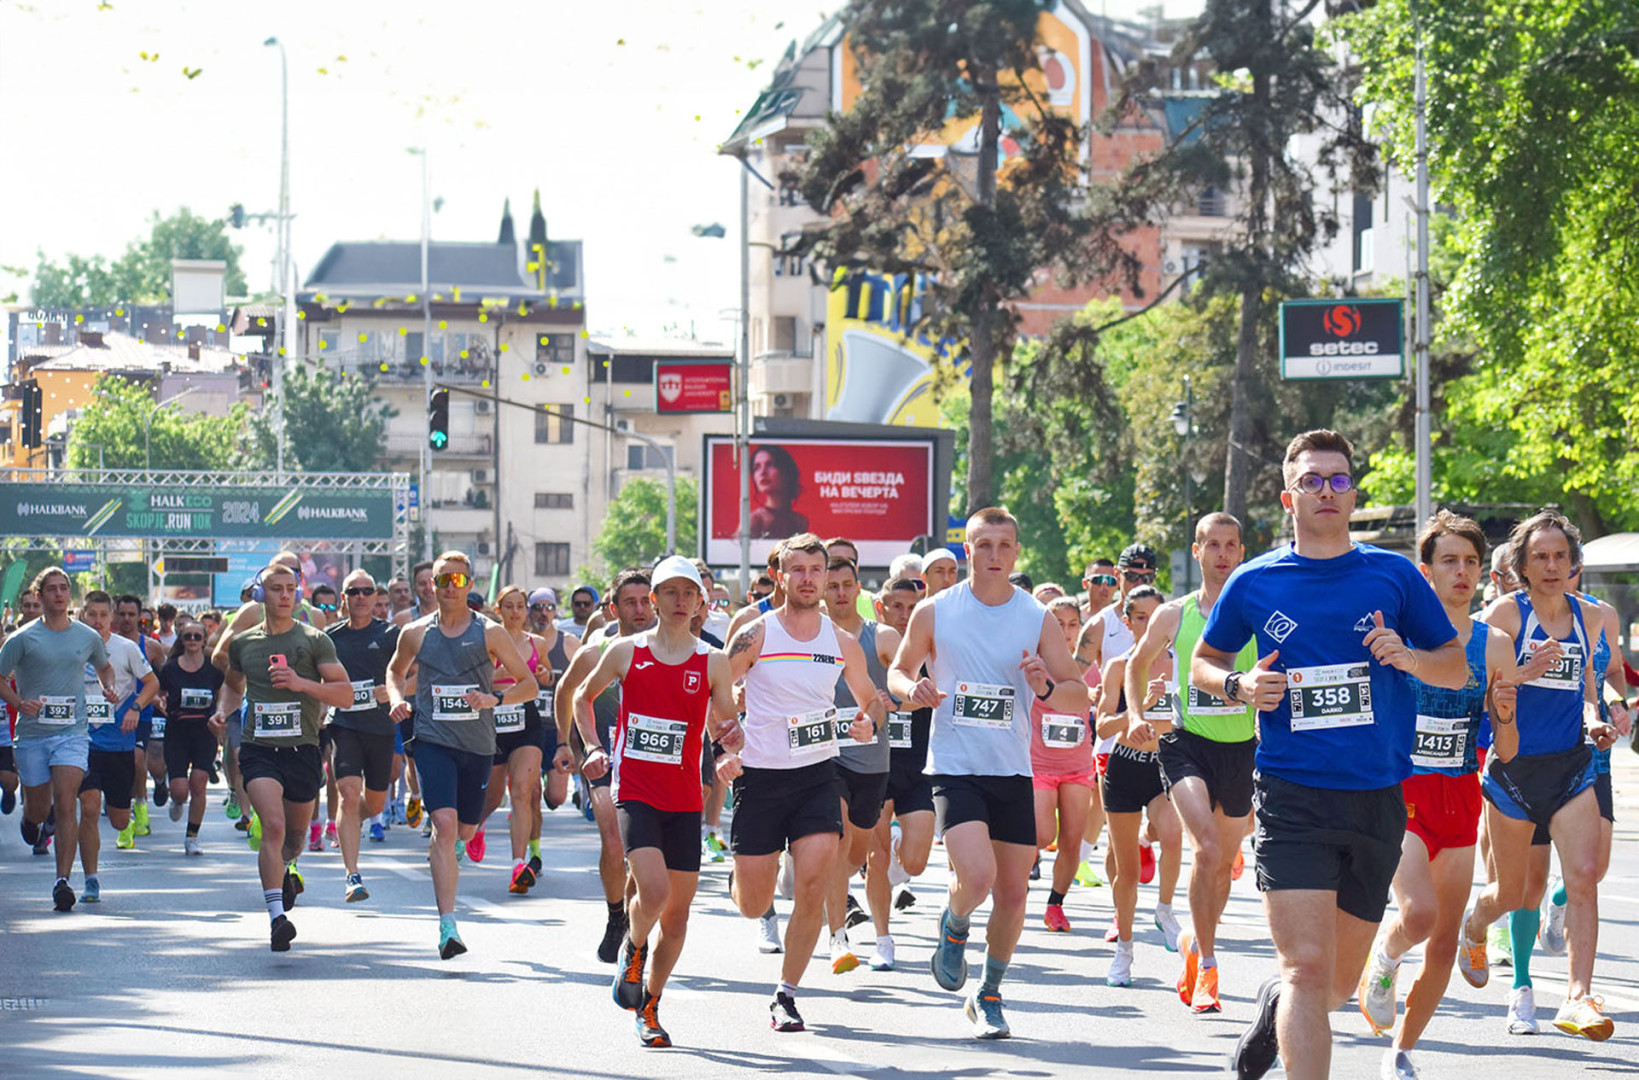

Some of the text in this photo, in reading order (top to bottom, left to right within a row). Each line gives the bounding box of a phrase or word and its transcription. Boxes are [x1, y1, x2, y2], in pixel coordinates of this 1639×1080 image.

[1309, 341, 1379, 356] setec
[814, 470, 851, 485] БИДИ
[820, 485, 899, 499] НА ВЕЧЕРТА
[30, 504, 87, 515] HALKBANK
[222, 501, 260, 523] 2024
[311, 508, 367, 518] HALKBANK
[192, 513, 212, 529] 10K
[813, 653, 836, 664] 226ERS
[688, 676, 698, 686] P
[441, 698, 470, 708] 1543
[1311, 687, 1351, 706] 358
[49, 706, 67, 715] 392
[86, 705, 105, 713] 904
[972, 699, 998, 713] 747
[267, 715, 288, 725] 391
[496, 714, 518, 723] 1633
[805, 724, 825, 738] 161
[836, 722, 852, 734] 10
[1059, 727, 1068, 737] 4
[640, 732, 669, 747] 966
[1417, 734, 1453, 750] 1413
[1114, 745, 1148, 762] NIKE
